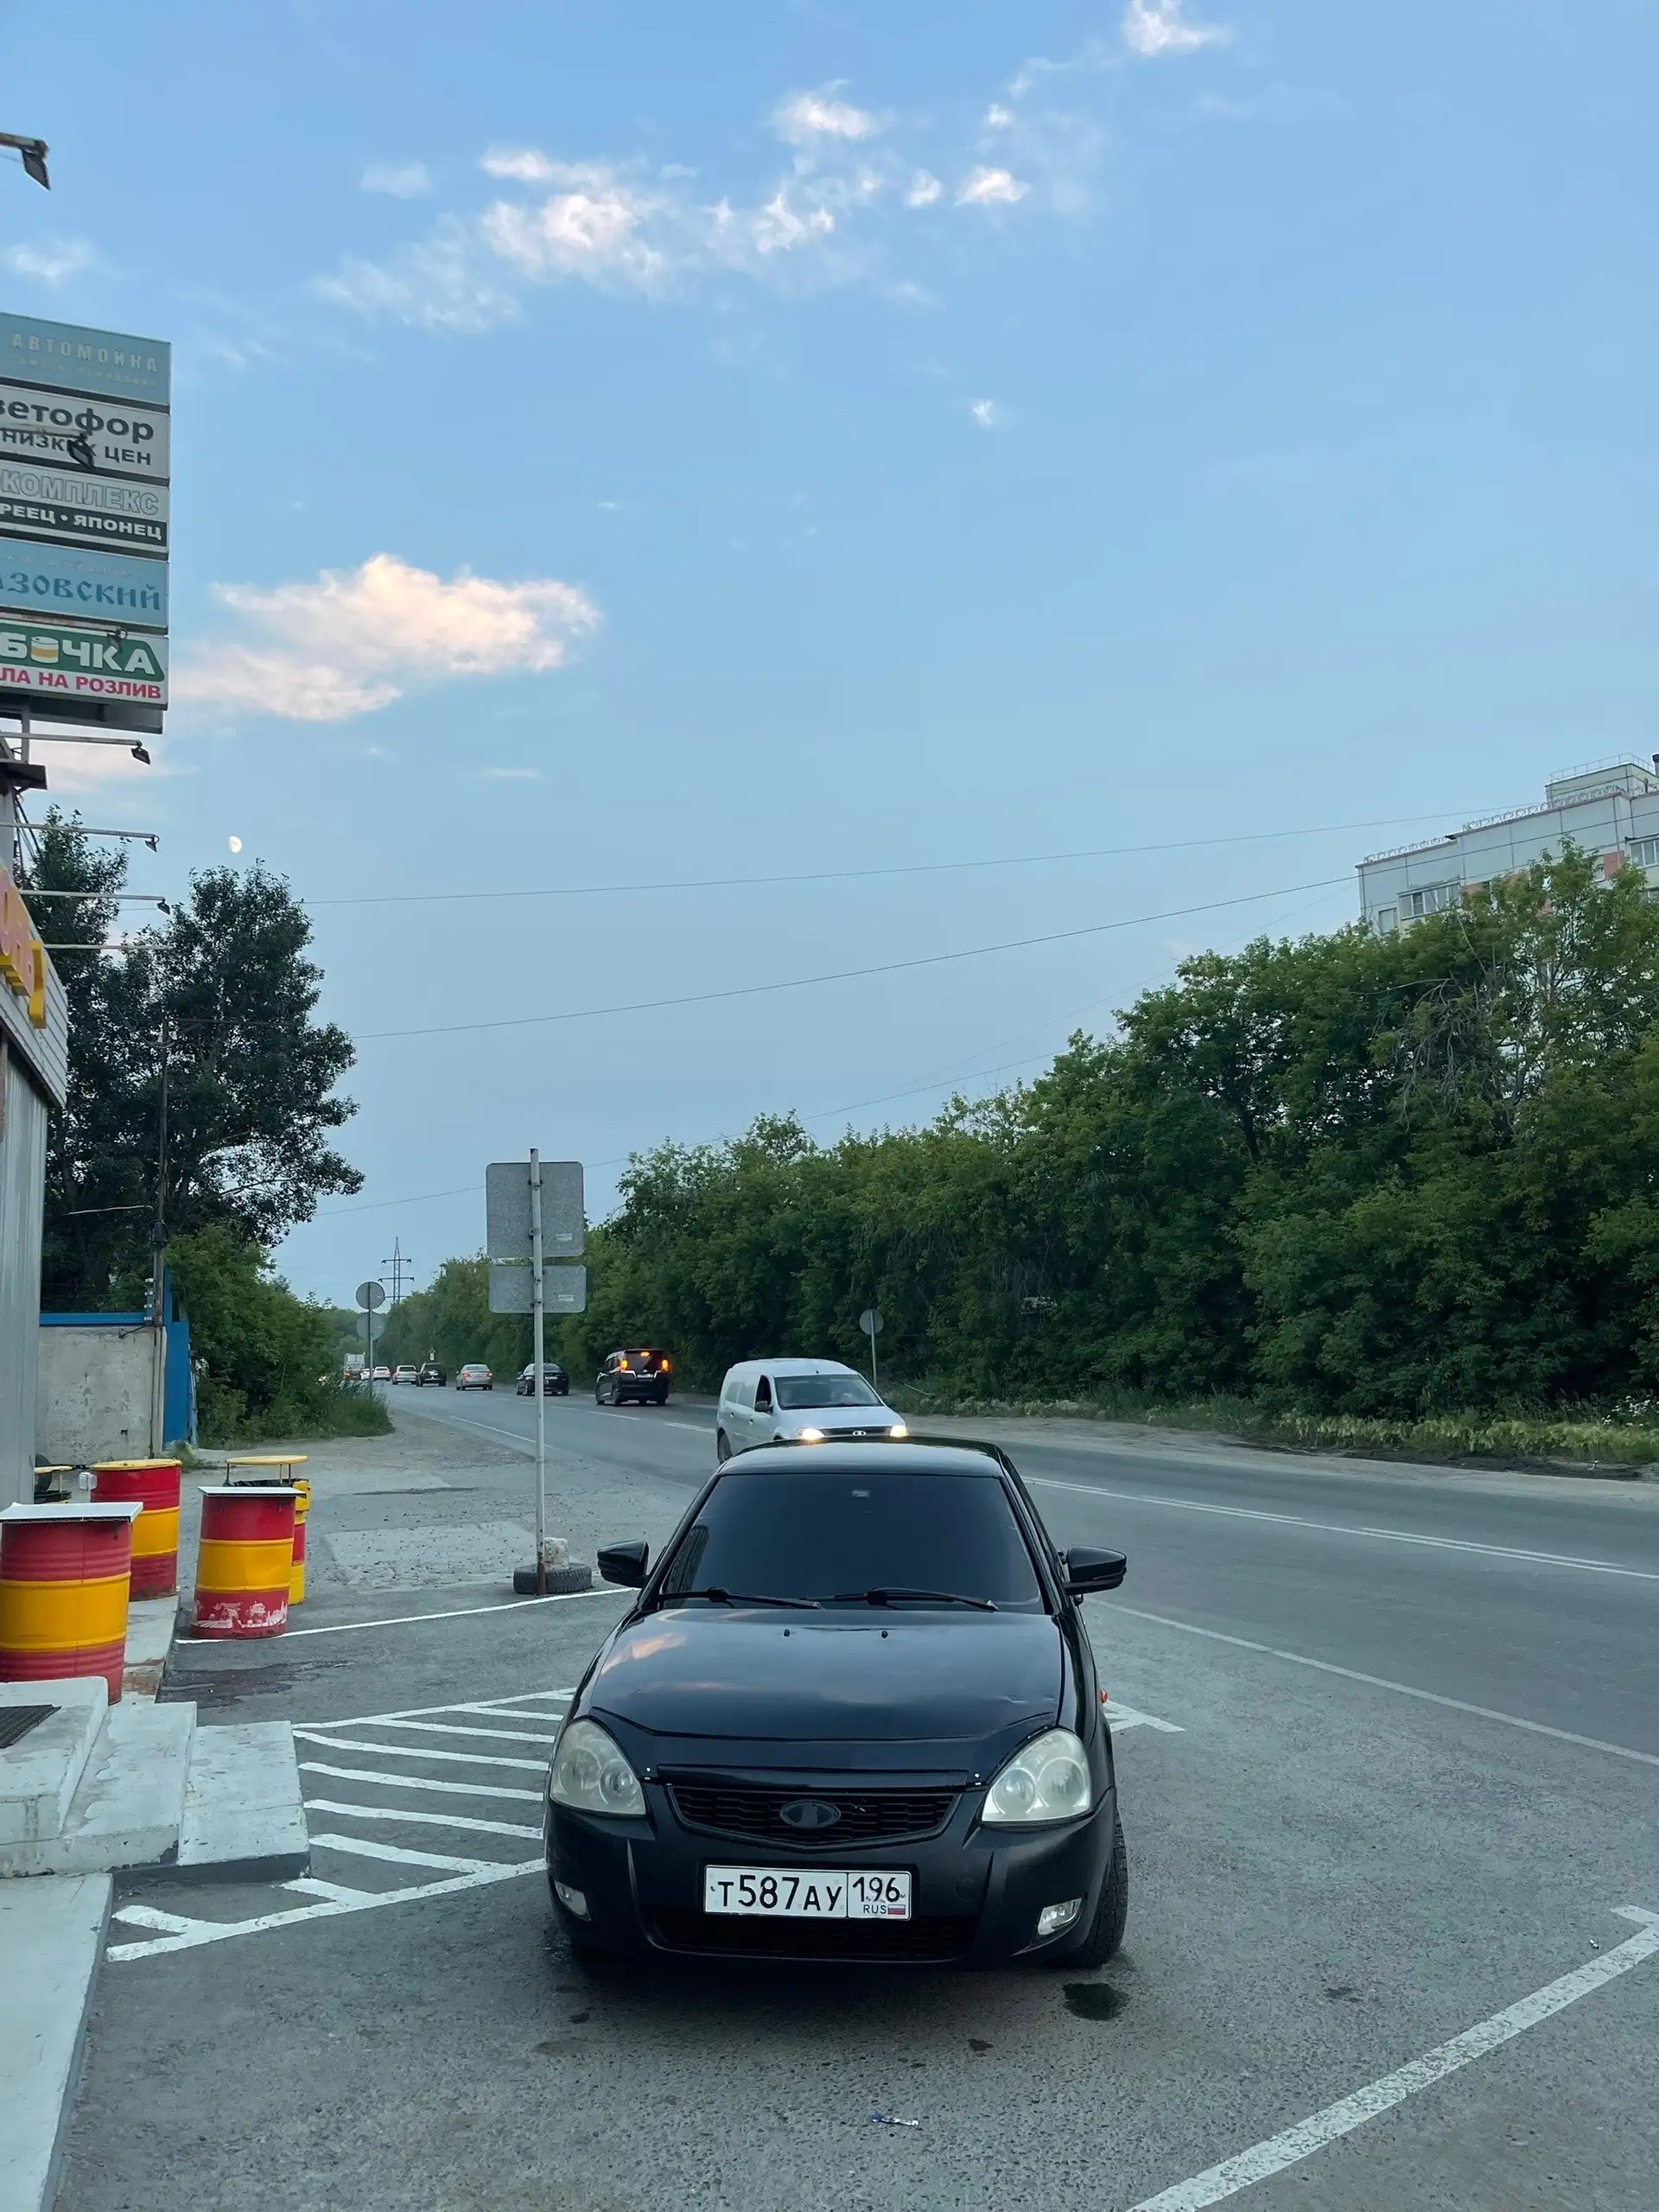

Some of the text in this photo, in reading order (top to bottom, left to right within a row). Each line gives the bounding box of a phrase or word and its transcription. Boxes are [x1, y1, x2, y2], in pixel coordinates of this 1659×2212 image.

[0, 399, 154, 444] етофор
[105, 446, 151, 466] ЦЕН
[2, 469, 159, 516] КОМПЛЕКС
[73, 514, 162, 541] ЯПОНЕЦ
[0, 572, 160, 611] ЗОВСКИЙ
[38, 671, 68, 689] НА
[76, 676, 162, 699] РОЗЛИВ
[853, 1877, 900, 1903] 196
[863, 1904, 887, 1915] RUS
